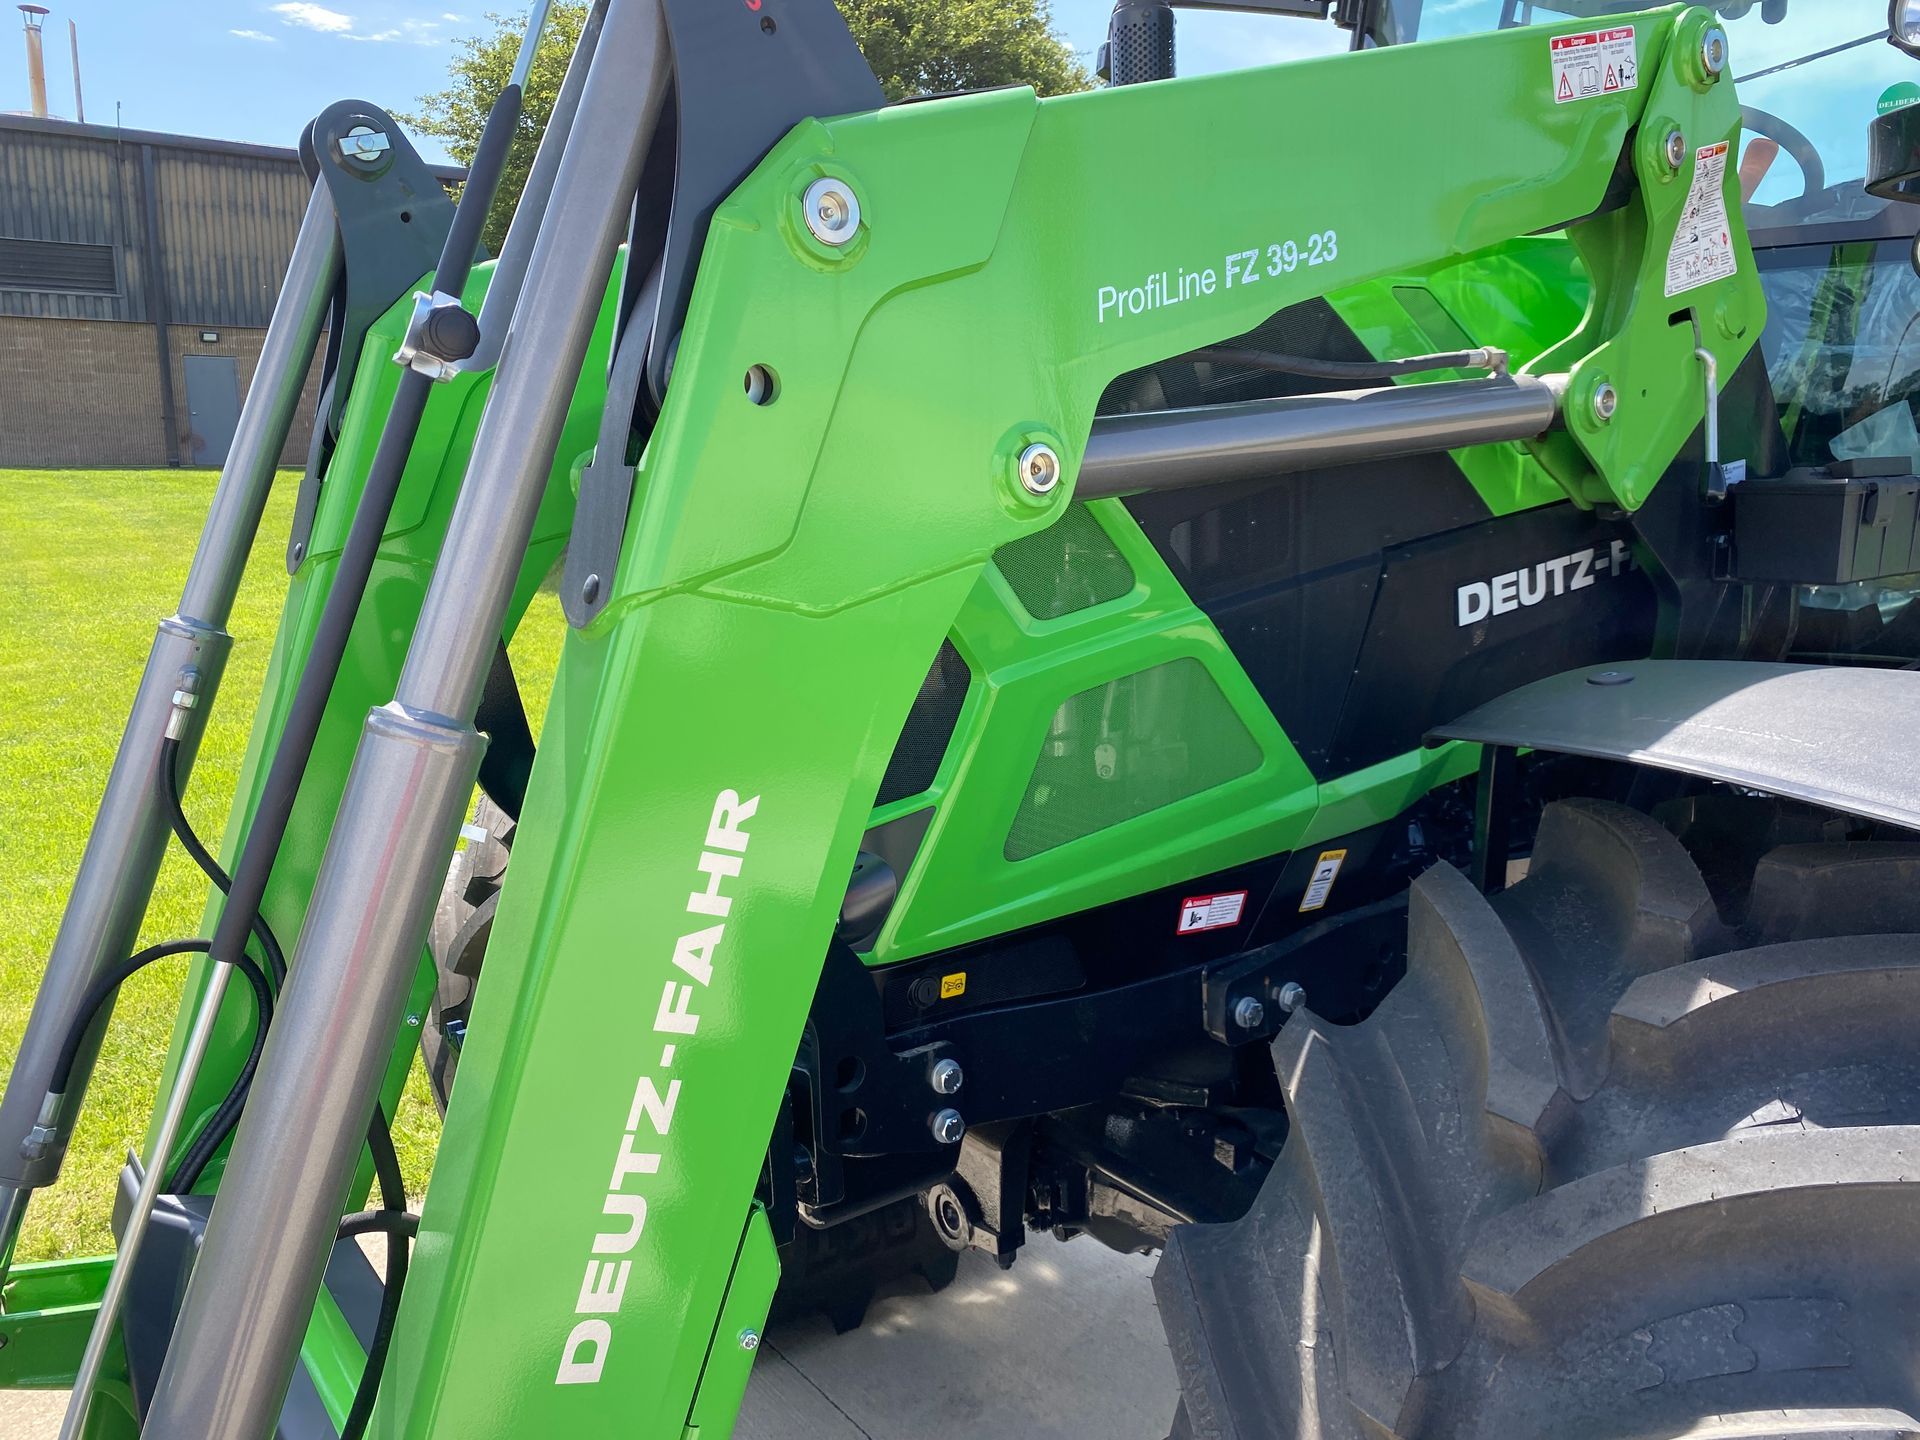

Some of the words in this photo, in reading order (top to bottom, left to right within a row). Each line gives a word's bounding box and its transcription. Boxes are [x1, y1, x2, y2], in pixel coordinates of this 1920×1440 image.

[1098, 268, 1217, 323] ProfiLine
[1225, 248, 1259, 289] FZ
[1266, 230, 1337, 277] 39-23
[1458, 539, 1639, 626] DEUTZ-F
[555, 788, 761, 1385] DEUTZ-FAHR
